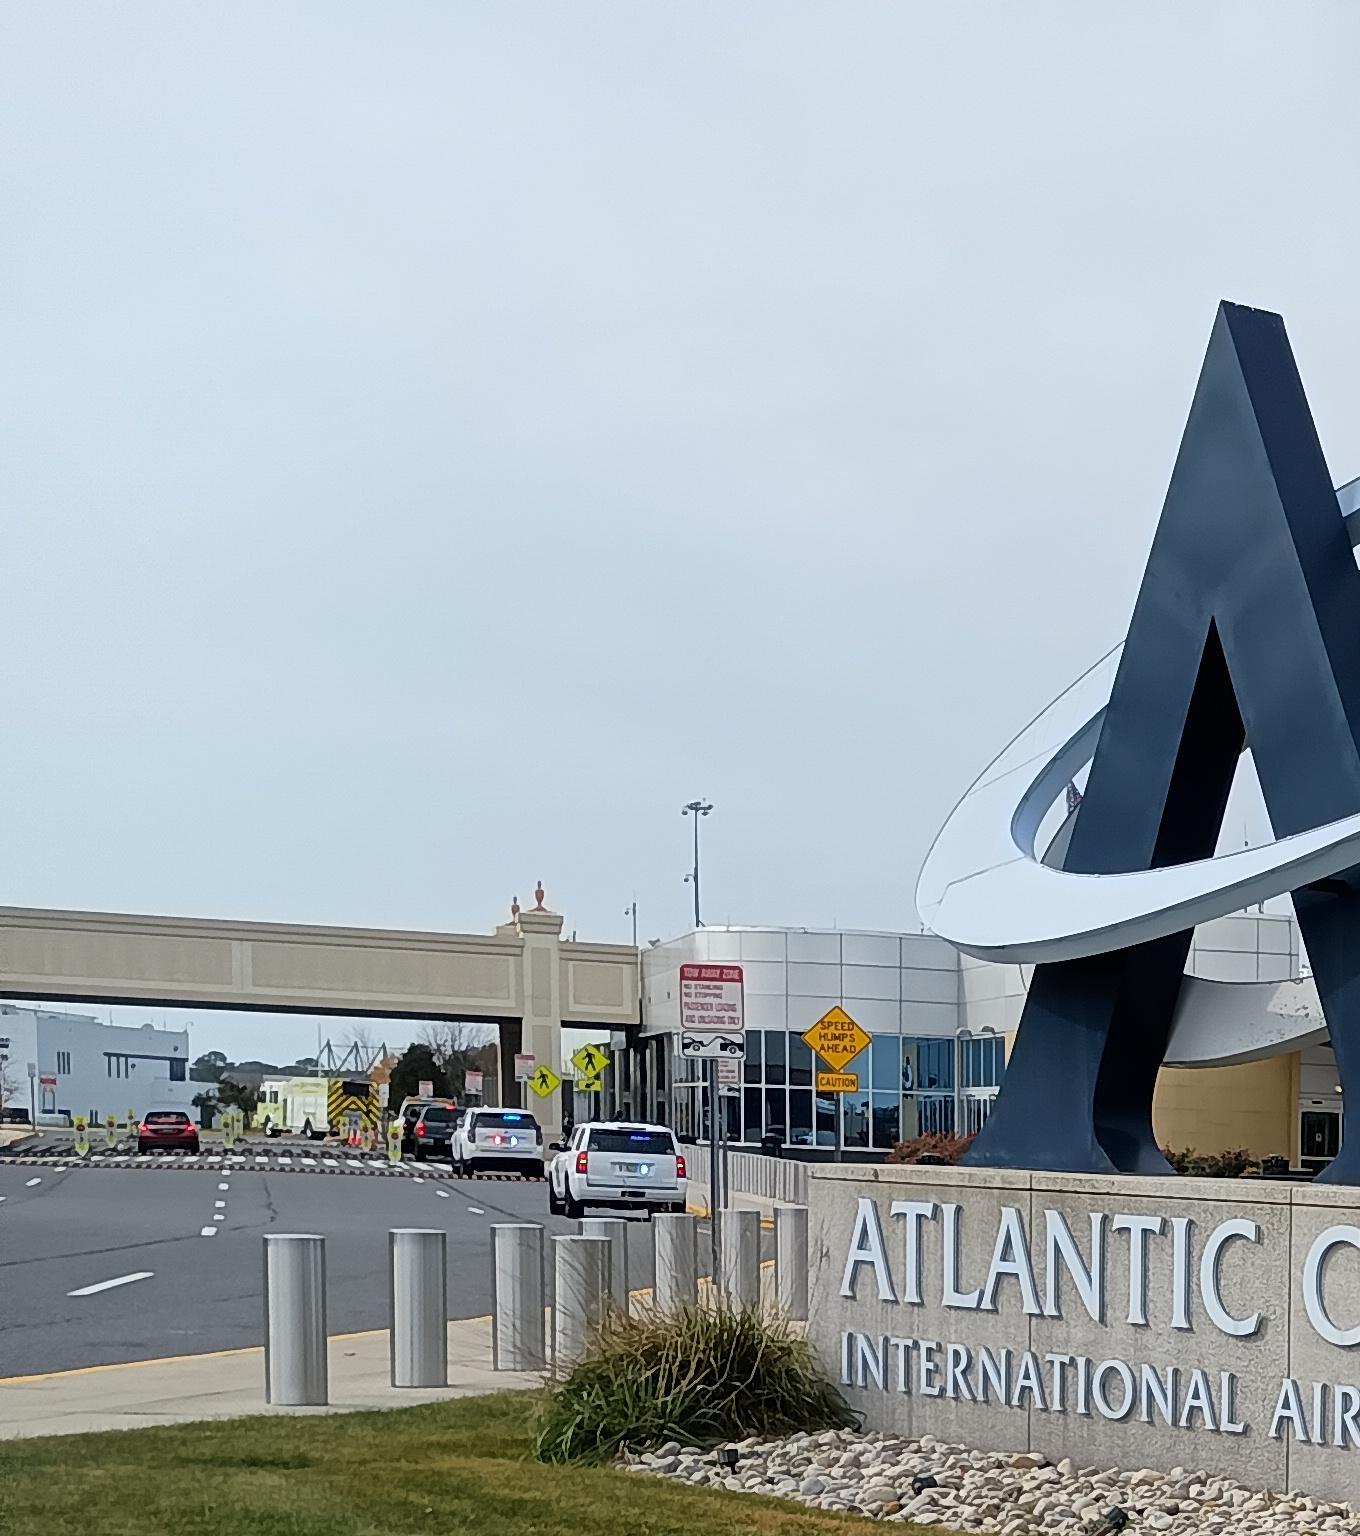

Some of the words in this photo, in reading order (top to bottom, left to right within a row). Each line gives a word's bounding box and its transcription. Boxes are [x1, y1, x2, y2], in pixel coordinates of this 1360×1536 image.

[820, 1021, 855, 1031] SPEED
[819, 1032, 856, 1042] HUMPS
[819, 1043, 857, 1054] AHEAD
[820, 1076, 856, 1087] CAUTION
[840, 1198, 1263, 1337] ATLANTIC
[840, 1332, 1248, 1435] INTERNATIONAL
